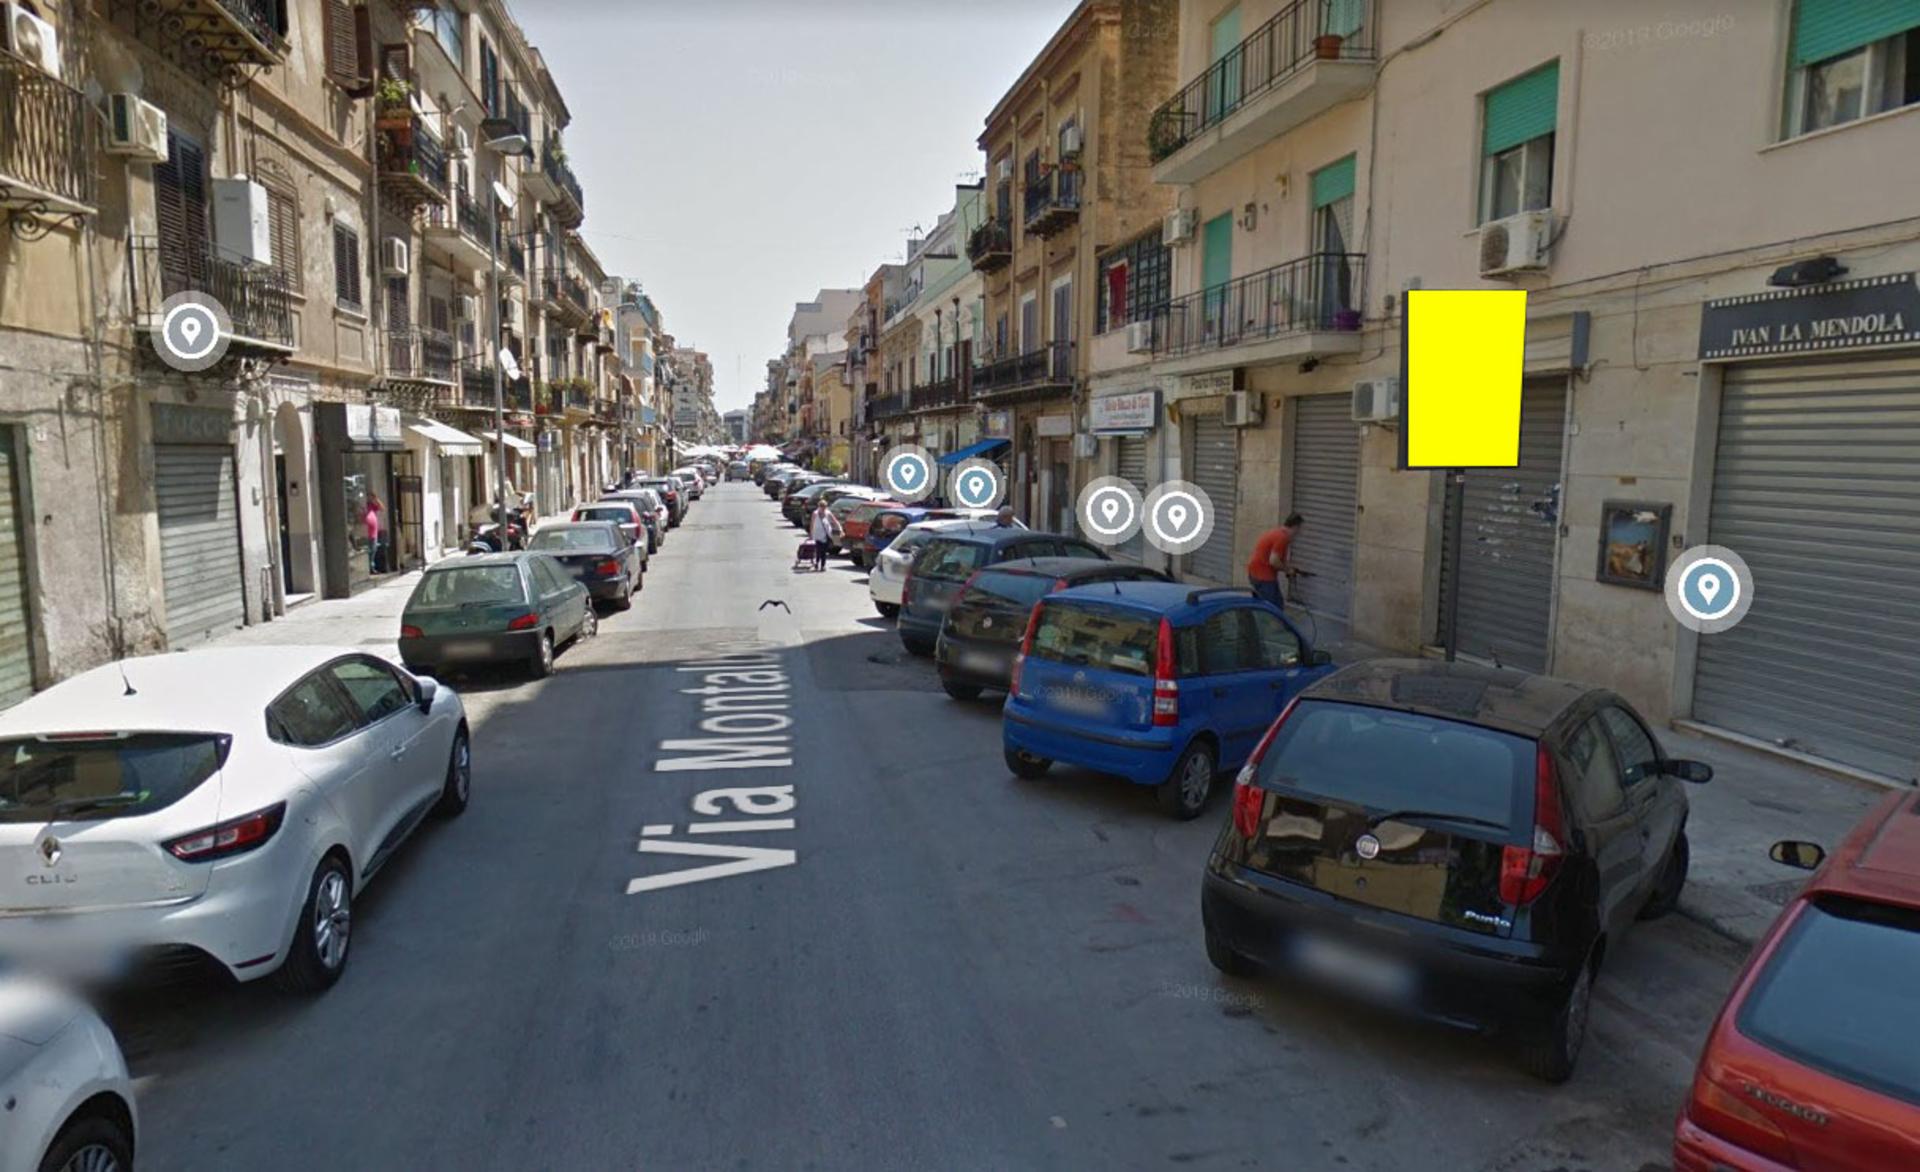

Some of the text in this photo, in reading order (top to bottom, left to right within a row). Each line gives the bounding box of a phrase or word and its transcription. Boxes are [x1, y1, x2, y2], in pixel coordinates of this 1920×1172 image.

[1731, 312, 1905, 347] IVAN LA MENDOLA
[1464, 910, 1511, 927] Punto
